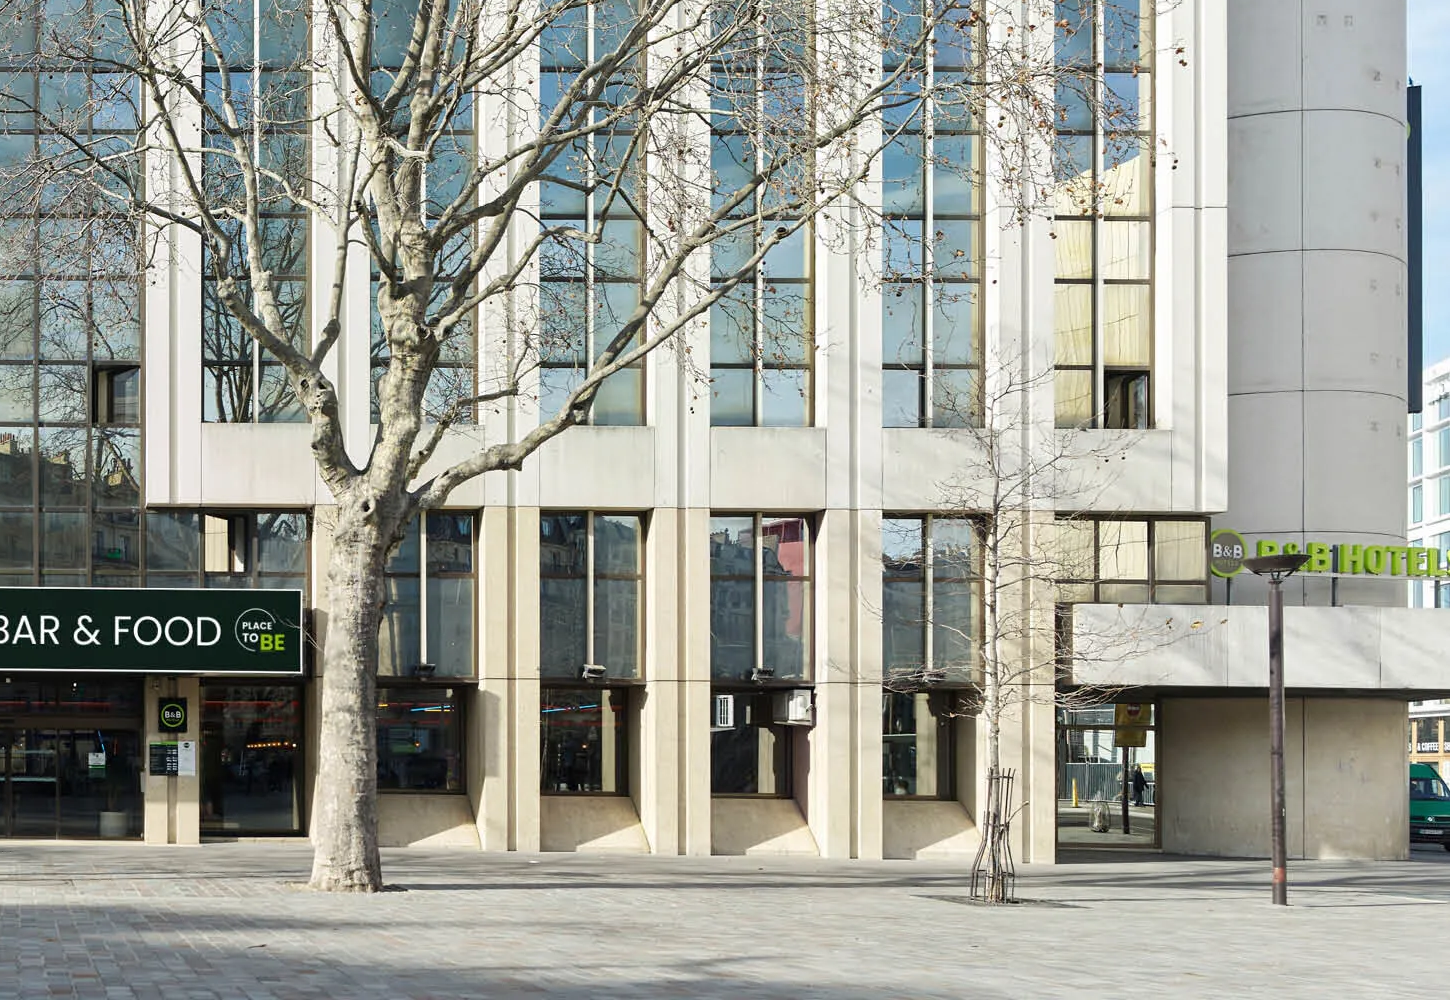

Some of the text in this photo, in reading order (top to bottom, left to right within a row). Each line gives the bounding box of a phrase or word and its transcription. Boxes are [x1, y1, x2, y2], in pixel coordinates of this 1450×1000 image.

[1213, 543, 1243, 559] B&B
[72, 614, 102, 646] &
[113, 615, 222, 647] FOOD
[242, 621, 272, 630] PLACE
[242, 633, 285, 651] TO BE
[164, 710, 182, 719] B&B
